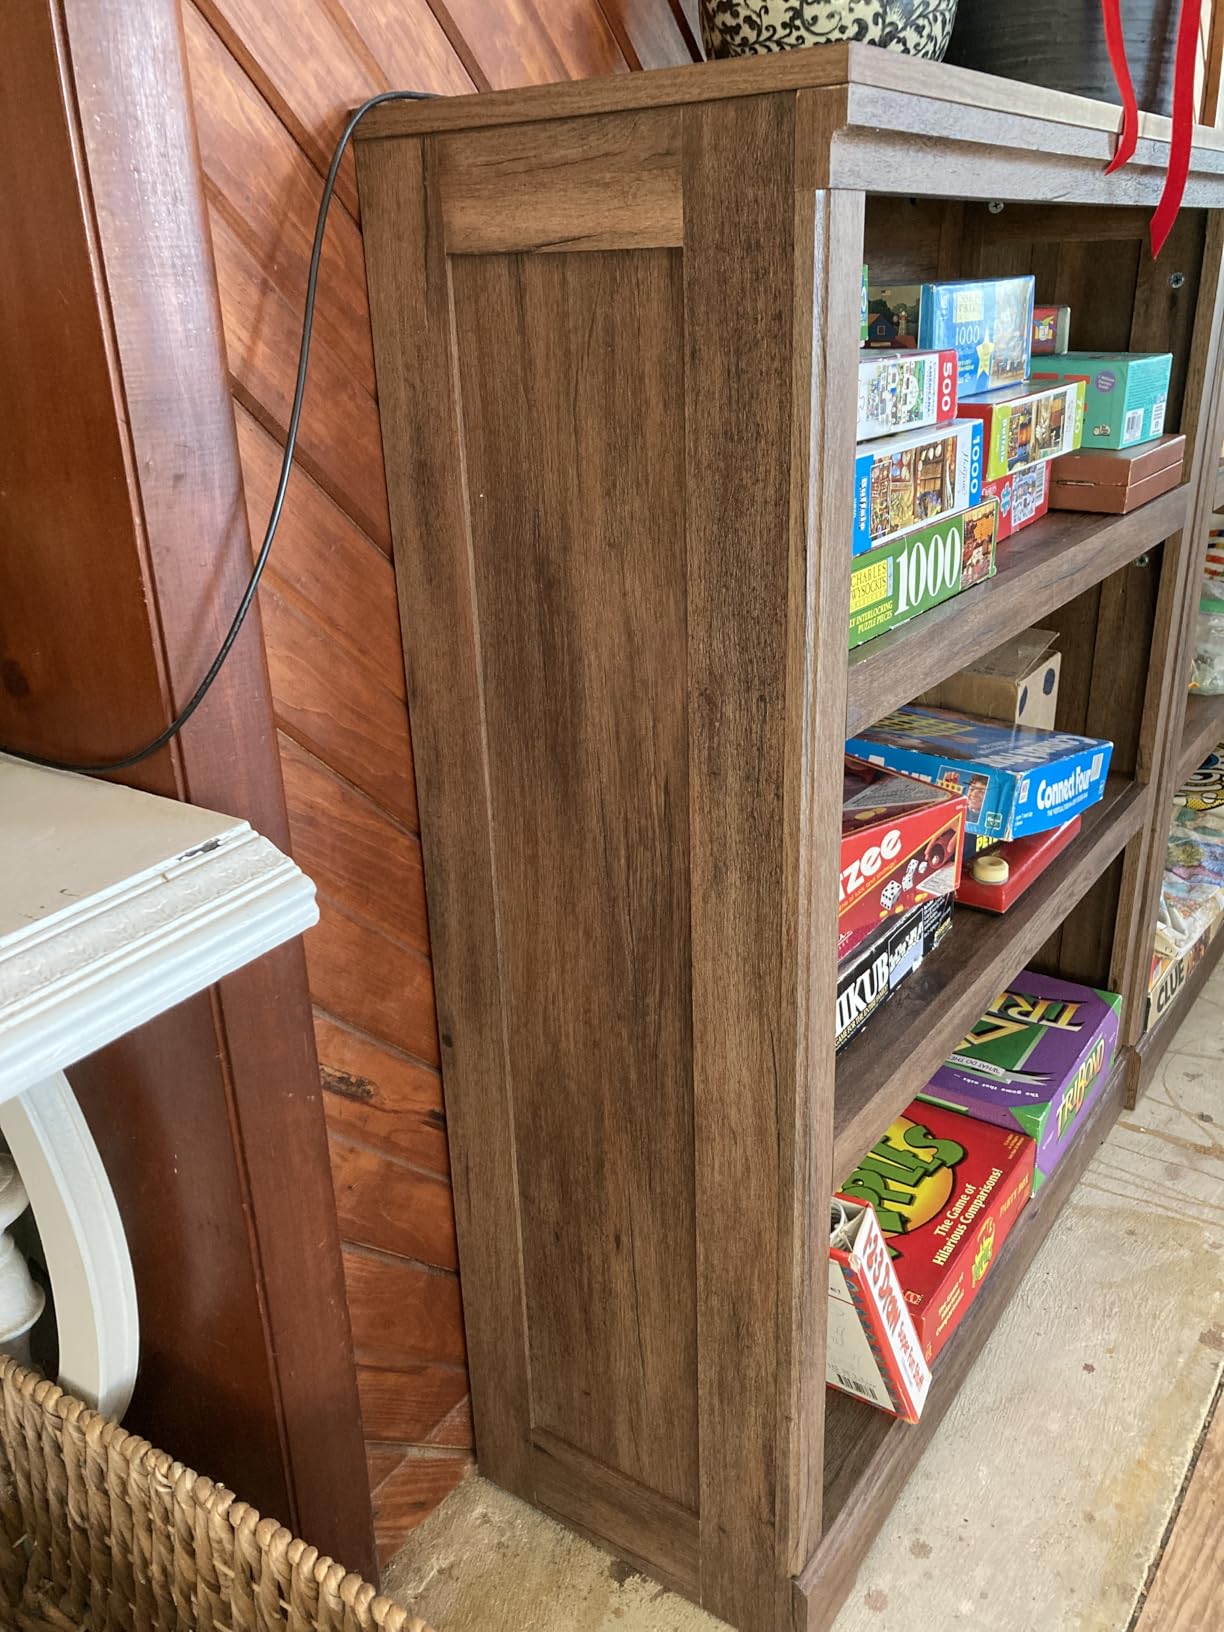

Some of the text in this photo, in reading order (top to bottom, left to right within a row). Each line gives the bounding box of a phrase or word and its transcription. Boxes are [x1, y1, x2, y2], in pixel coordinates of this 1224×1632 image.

[955, 325, 980, 347] 1000
[941, 361, 953, 412] 500
[970, 434, 981, 495] 1000
[851, 562, 886, 588] CHARLES
[895, 527, 961, 617] 1000
[856, 600, 893, 626] INTERLOCKING
[1037, 771, 1075, 810] Connect
[1075, 765, 1091, 796] Four
[1157, 956, 1185, 1013] CLUE
[981, 1083, 998, 1091] that
[1001, 1087, 1022, 1095] game
[842, 1125, 967, 1258] PPLES
[932, 1222, 968, 1267] Hilarious
[964, 1167, 1003, 1224] Comparisons!
[934, 1183, 977, 1238] The Game of
